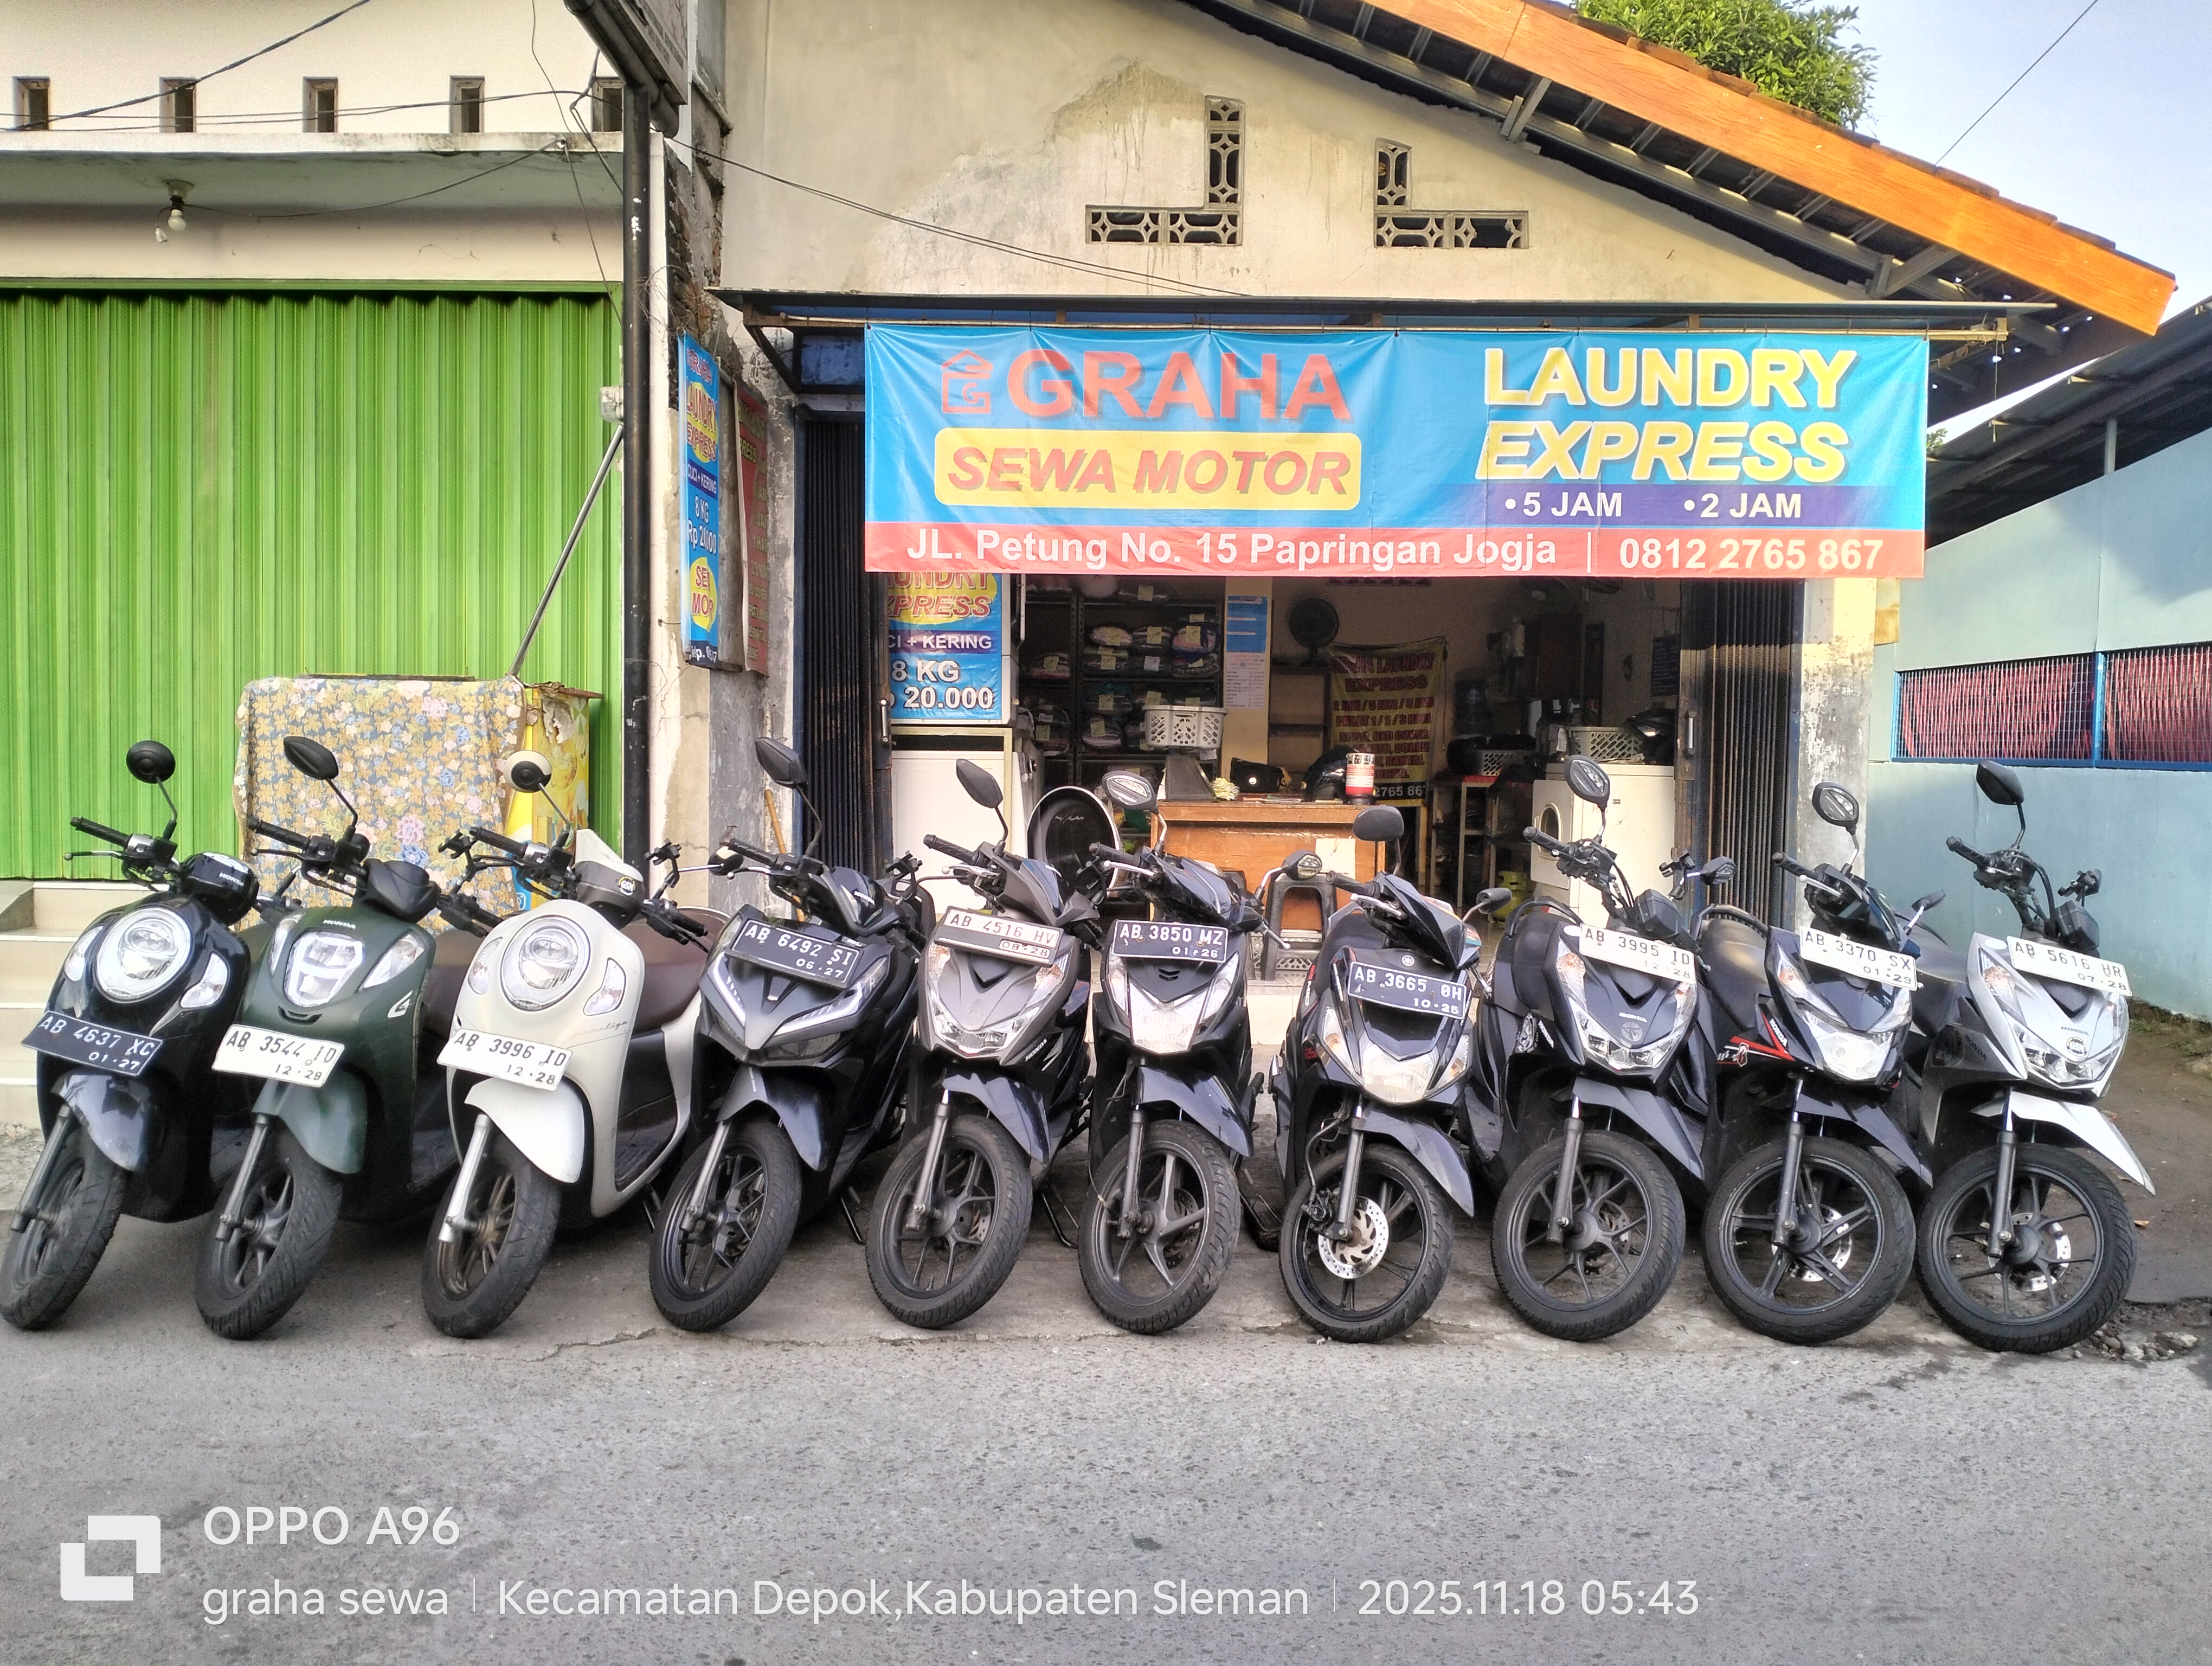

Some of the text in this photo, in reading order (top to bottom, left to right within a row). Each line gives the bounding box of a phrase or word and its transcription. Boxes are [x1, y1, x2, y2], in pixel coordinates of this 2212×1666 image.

[1007, 349, 1351, 420] GRAHA
[1484, 348, 1857, 408] LAUNDRY
[1475, 421, 1849, 482] EXPRESS
[948, 447, 1350, 495] SEWA MOTOR
[1551, 492, 1622, 517] JAM
[1729, 493, 1801, 518] JAM
[907, 529, 1555, 572] JL. Petung No. 15 Papringan Jogja
[1620, 538, 1883, 570] 0812 2765 867
[922, 634, 993, 650] KERING
[891, 659, 960, 682] 8 KG
[903, 686, 994, 710] 20.000
[950, 914, 1054, 944] AB 4516 HV
[1120, 924, 1224, 945] AB 3850 MZ
[745, 925, 852, 966] AB 6492 SI
[1585, 928, 1690, 965] AB 3995 ID
[1805, 931, 1911, 971] AB 3370 SX
[2015, 941, 2123, 978] AB 5616 HR
[1354, 966, 1377, 983] AB
[1385, 972, 1427, 992] 3665
[38, 1016, 155, 1056] AB 4637 XC
[226, 1030, 252, 1048] AB
[259, 1036, 307, 1058] 3544
[1769, 1018, 1788, 1048] HONDA
[2061, 1026, 2090, 1036] HONDA
[454, 1032, 568, 1066] AB 3996 ID
